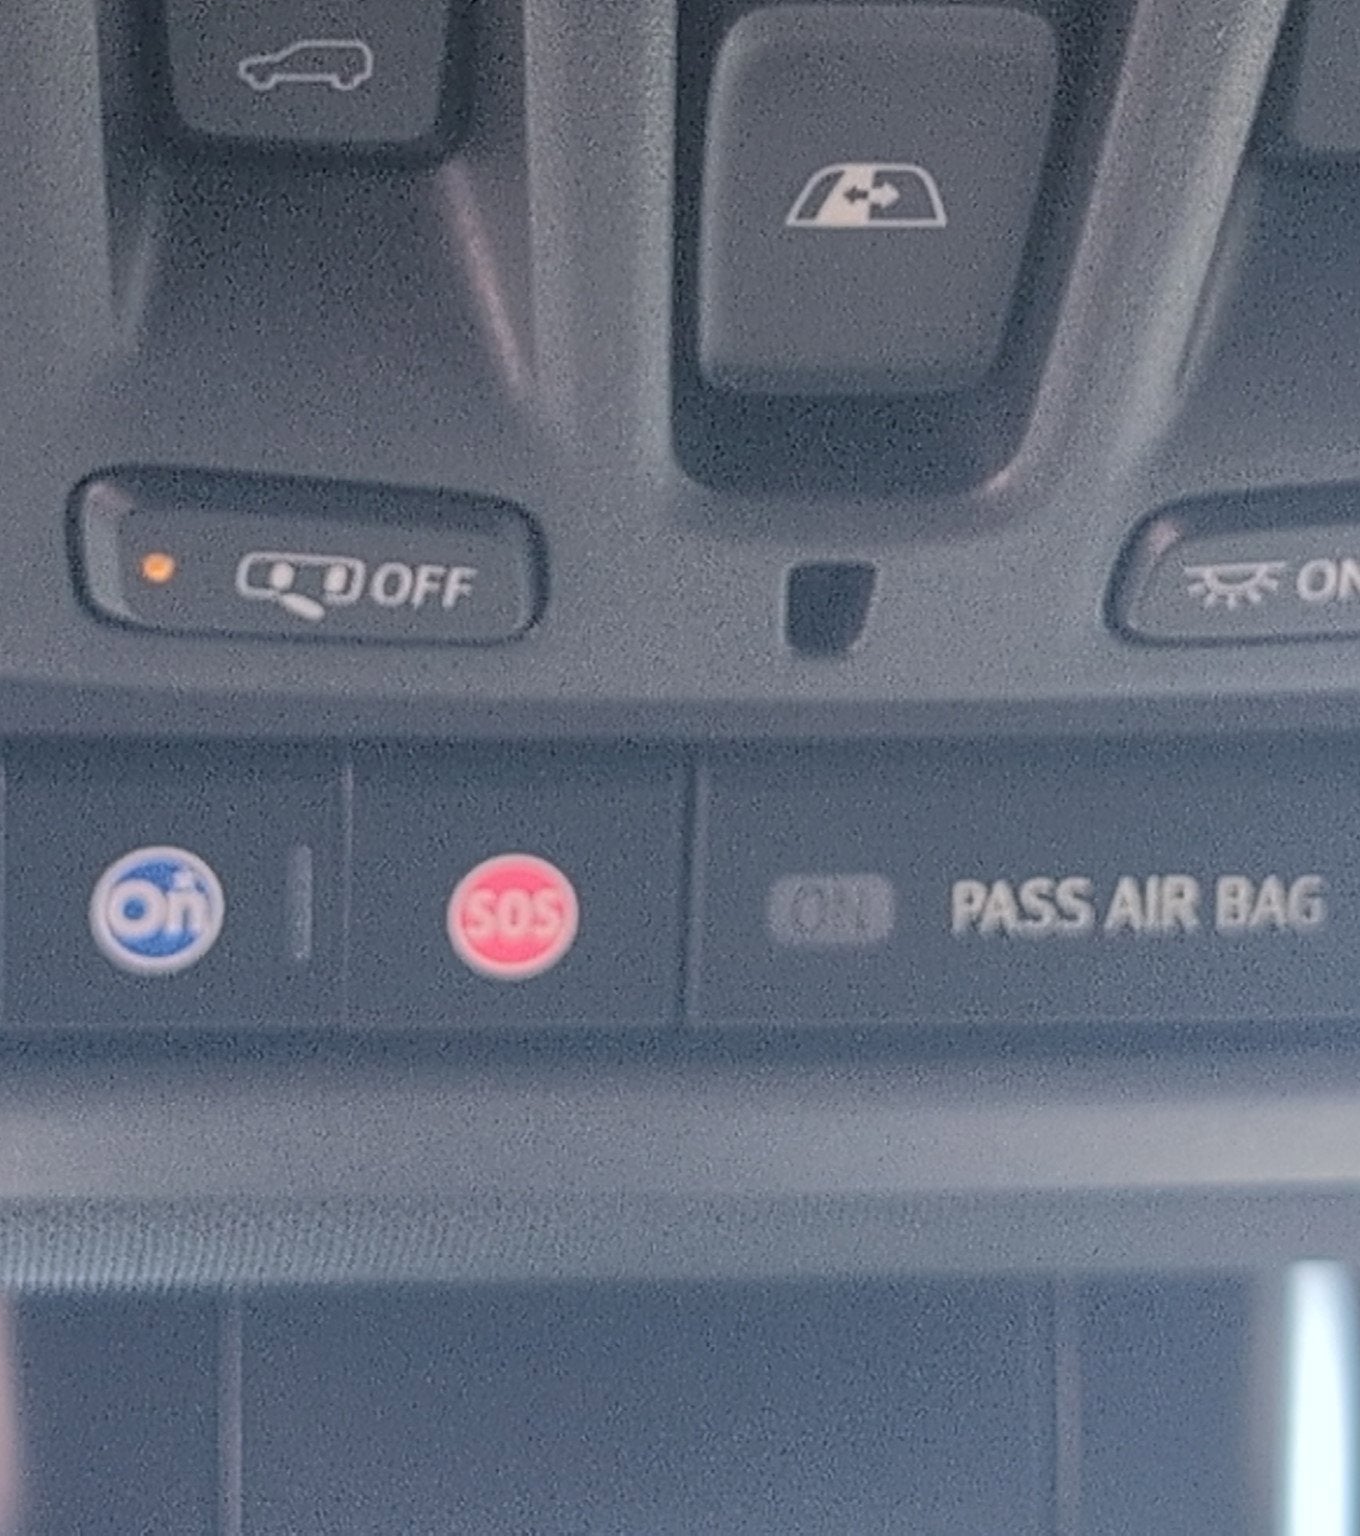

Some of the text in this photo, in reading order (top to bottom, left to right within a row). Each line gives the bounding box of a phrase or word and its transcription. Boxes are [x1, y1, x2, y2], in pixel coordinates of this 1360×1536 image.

[368, 563, 477, 609] OFF
[461, 886, 566, 940] SOS
[951, 875, 1095, 934] PASS
[1103, 873, 1201, 932] AIR
[1214, 873, 1327, 932] BAG
